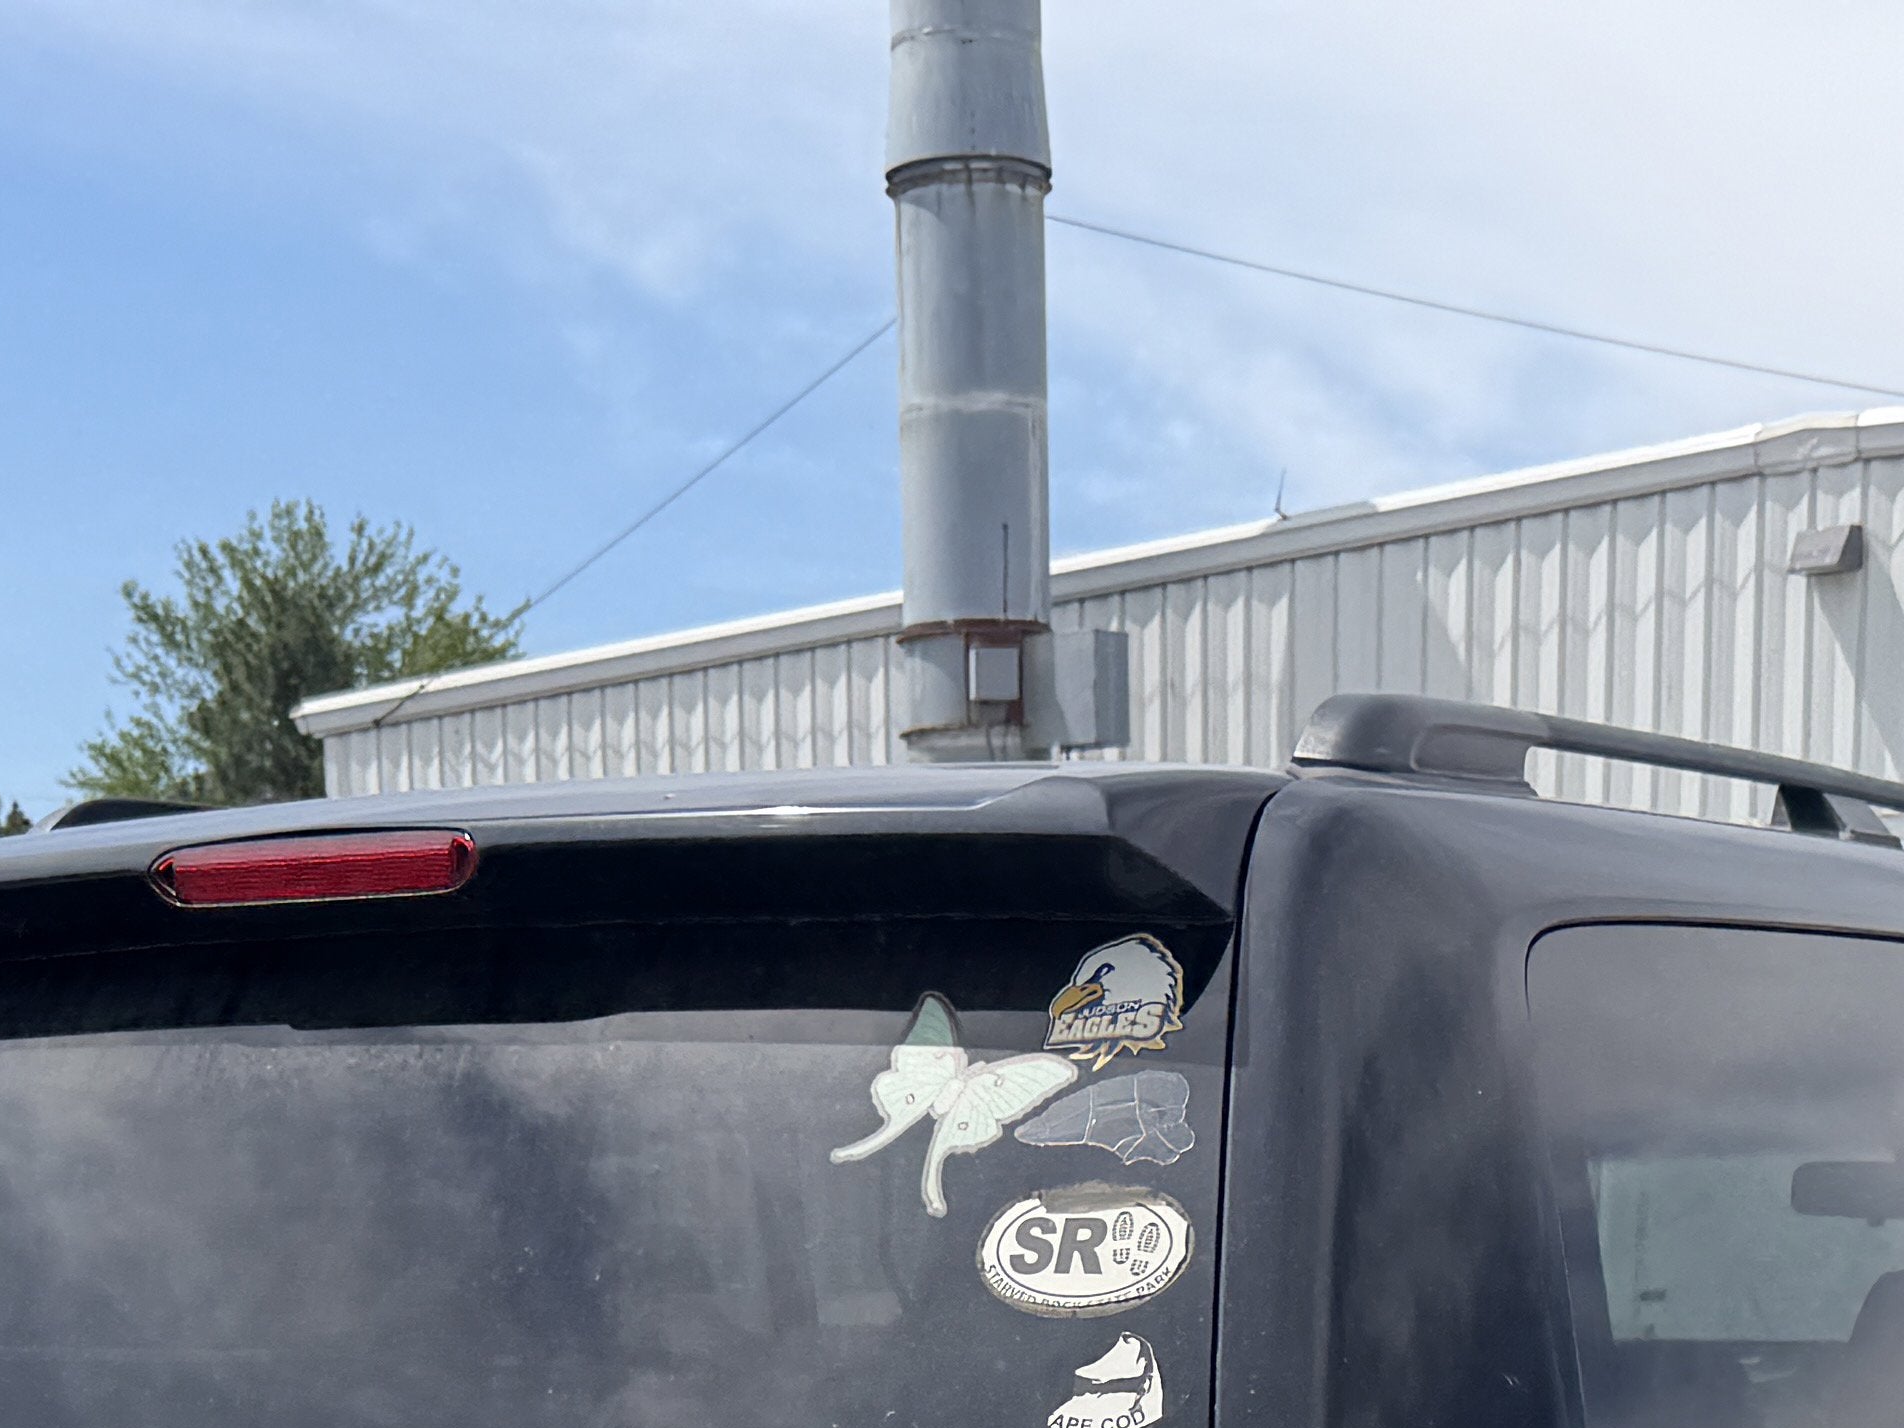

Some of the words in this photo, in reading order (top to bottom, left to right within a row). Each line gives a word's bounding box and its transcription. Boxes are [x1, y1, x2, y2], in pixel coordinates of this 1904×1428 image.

[1048, 1002, 1164, 1043] EAGLES
[1077, 999, 1142, 1018] JUDSON
[1009, 1217, 1108, 1275] SR
[1135, 1267, 1172, 1297] PARK
